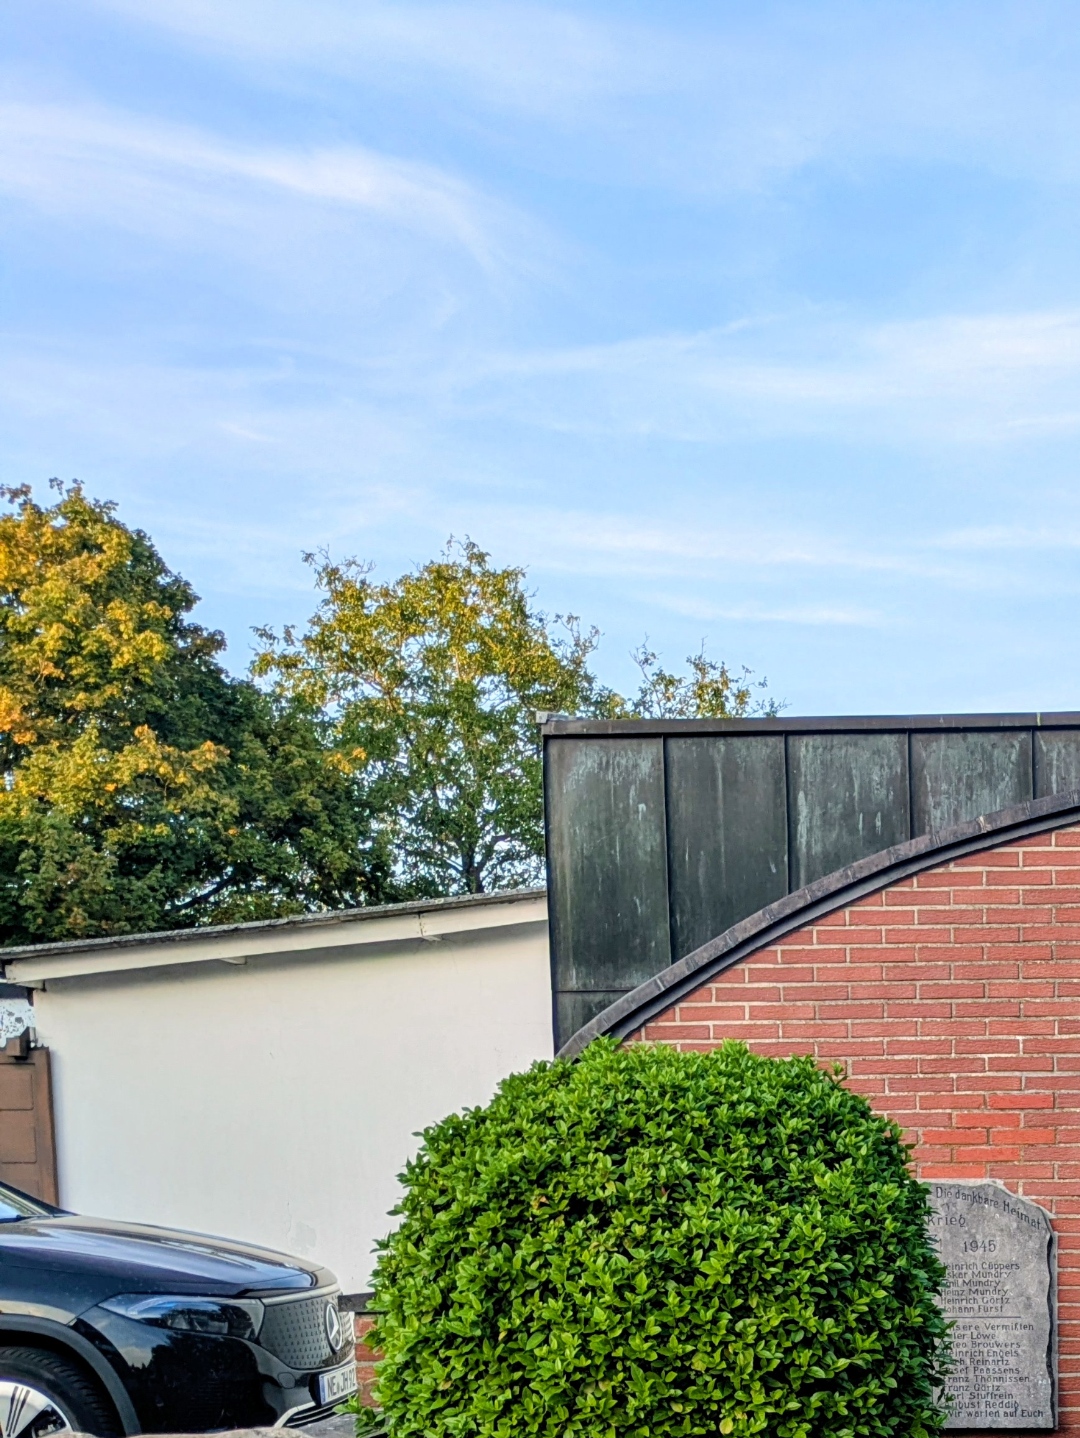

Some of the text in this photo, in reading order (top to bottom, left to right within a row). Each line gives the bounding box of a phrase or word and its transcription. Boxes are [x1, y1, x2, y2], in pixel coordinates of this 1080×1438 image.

[936, 1187, 1041, 1230] Die dankbare Heimat
[963, 1240, 996, 1253] 1945
[945, 1270, 1011, 1280] skar Mundry
[962, 1279, 1001, 1288] Mundry
[968, 1288, 1009, 1297] Mundry
[940, 1297, 979, 1305] Heinrich
[949, 1323, 980, 1331] nsere
[950, 1400, 981, 1409] ugust
[1021, 1409, 1044, 1418] Euch
